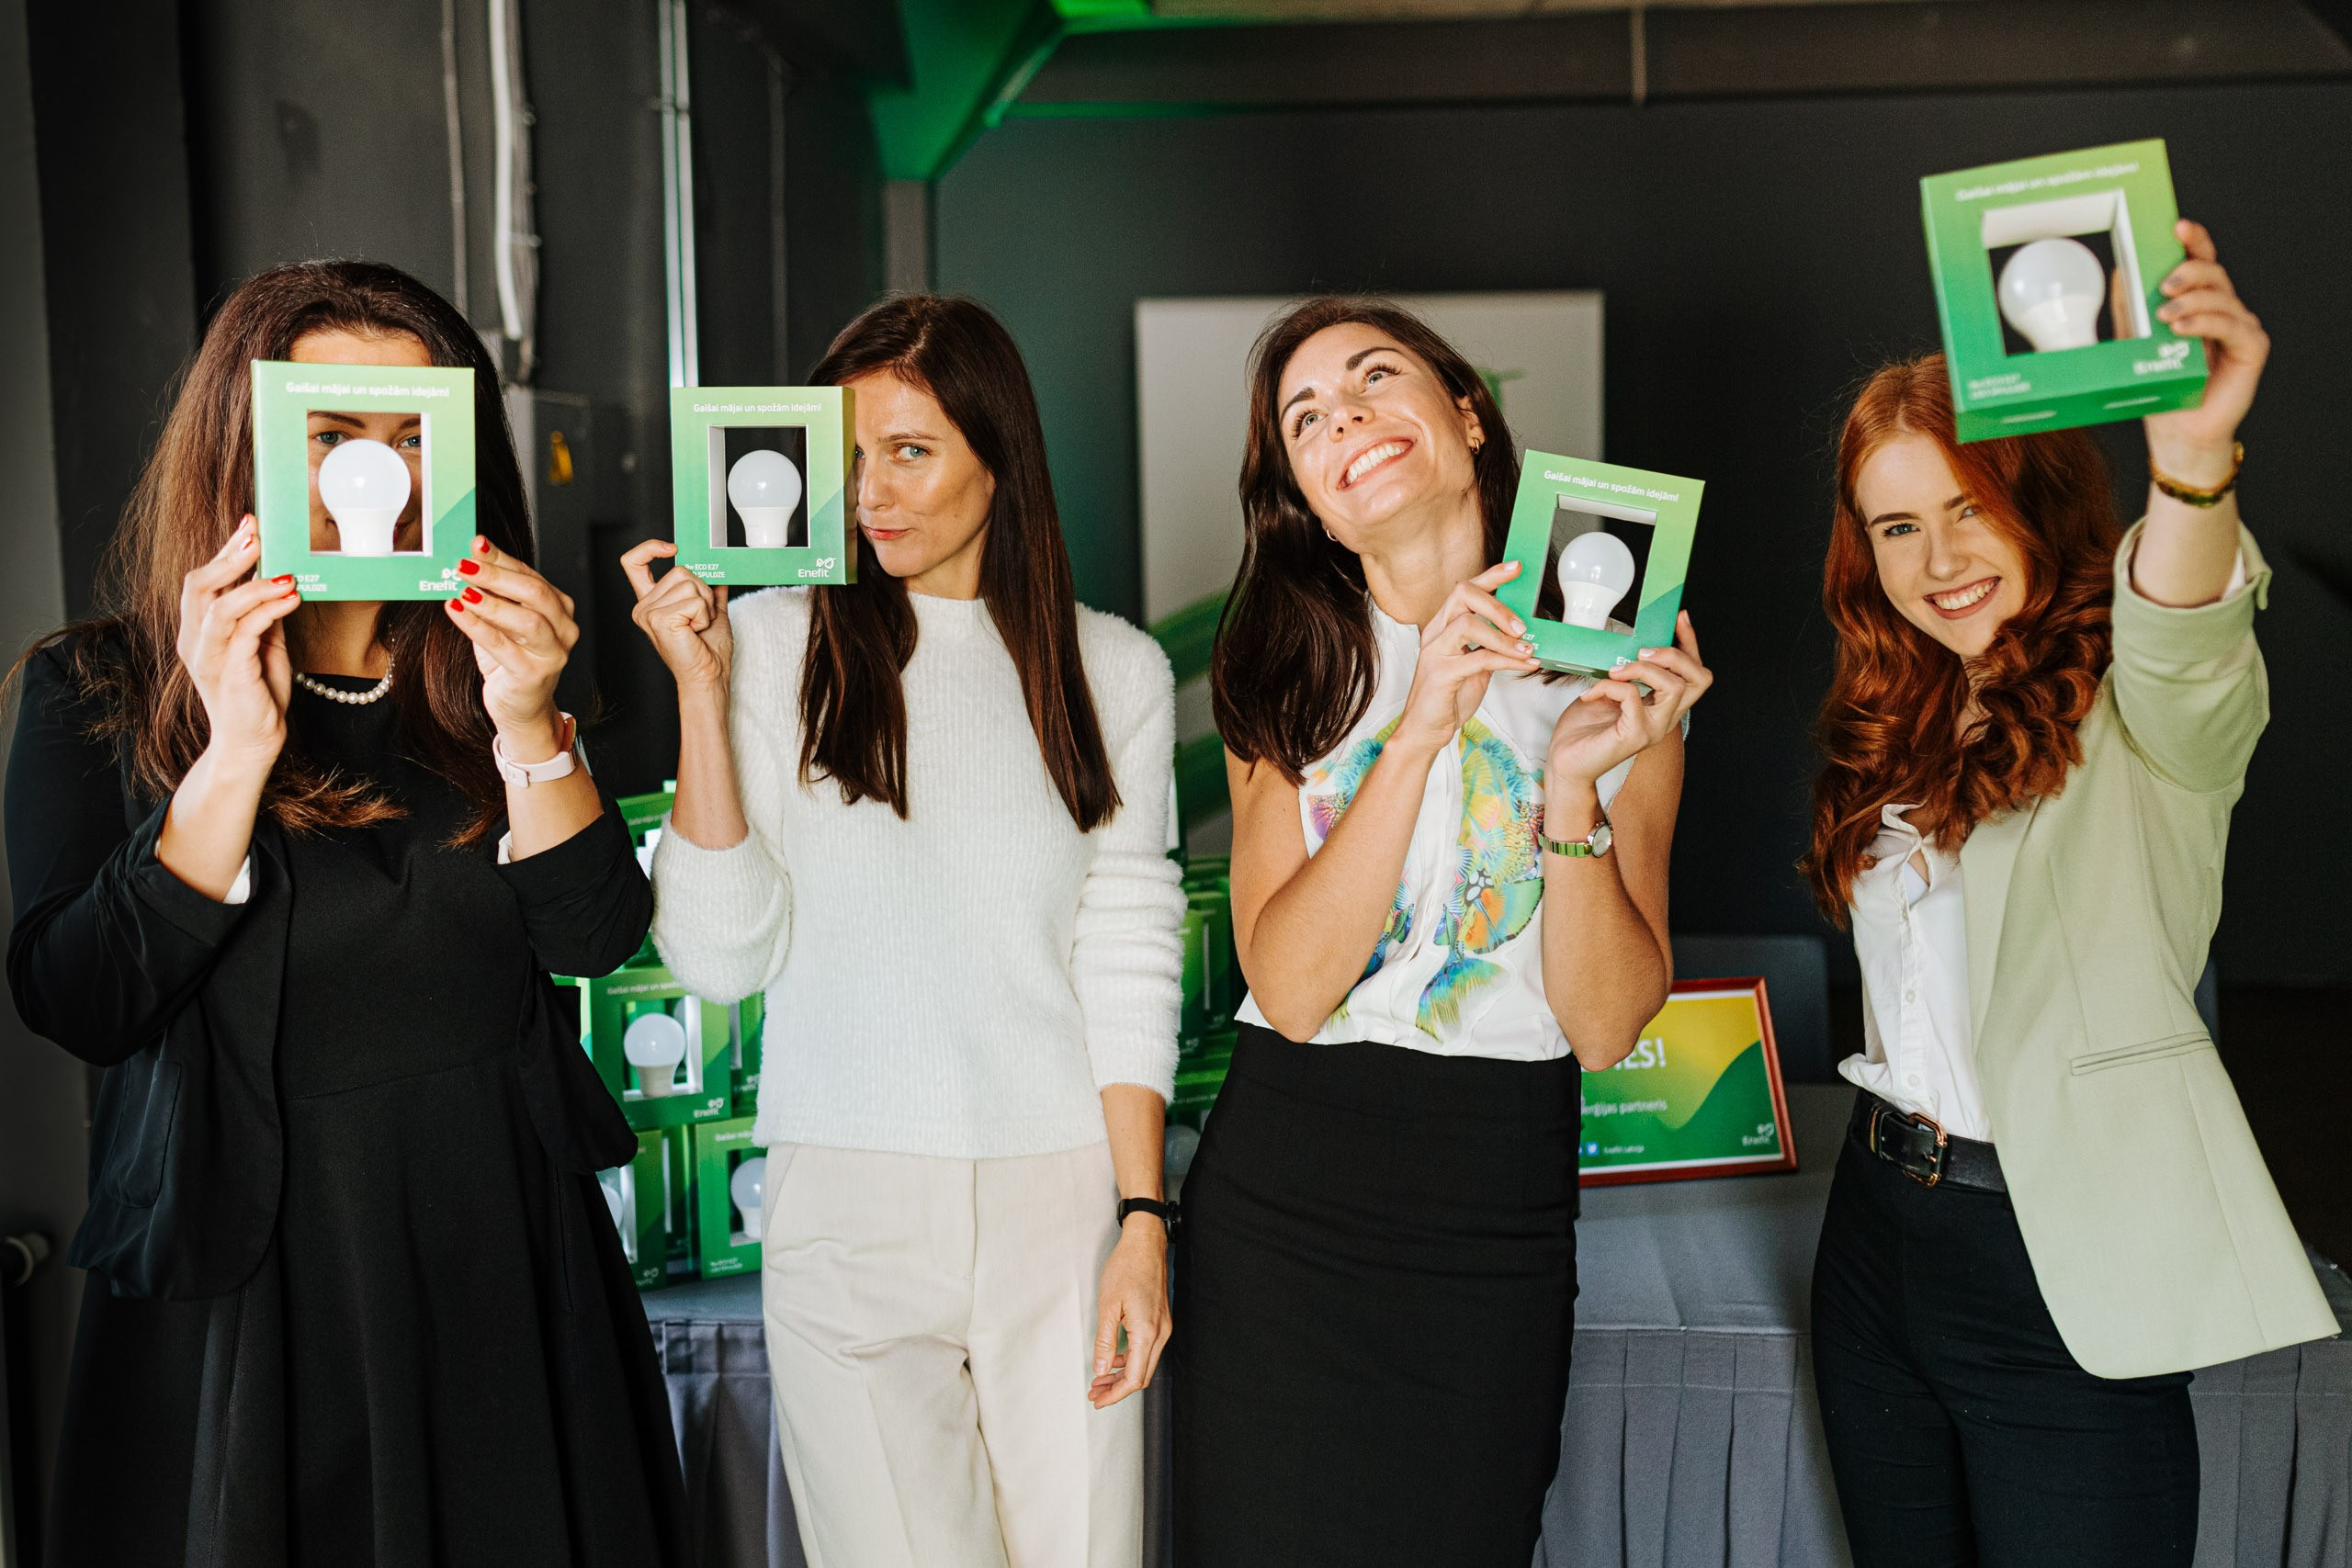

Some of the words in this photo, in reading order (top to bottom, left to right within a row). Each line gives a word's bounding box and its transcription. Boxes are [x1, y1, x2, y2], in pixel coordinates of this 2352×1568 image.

[286, 382, 320, 394] Gaišai
[322, 383, 351, 396] mājai
[352, 385, 367, 394] un
[368, 386, 410, 397] spožām
[694, 403, 719, 412] Gaišai
[720, 404, 743, 413] mājai
[744, 404, 755, 412] un
[757, 403, 790, 413] spožām
[791, 403, 821, 413] idejām!
[1544, 470, 1572, 483] Gaišai
[1572, 477, 1597, 489] mājai
[1598, 481, 1610, 490] un
[1611, 482, 1645, 496] spožām
[1646, 489, 1679, 502] idejām!
[797, 569, 830, 578] Enefit
[296, 583, 328, 592] PULDZE
[419, 580, 458, 592] Enefit
